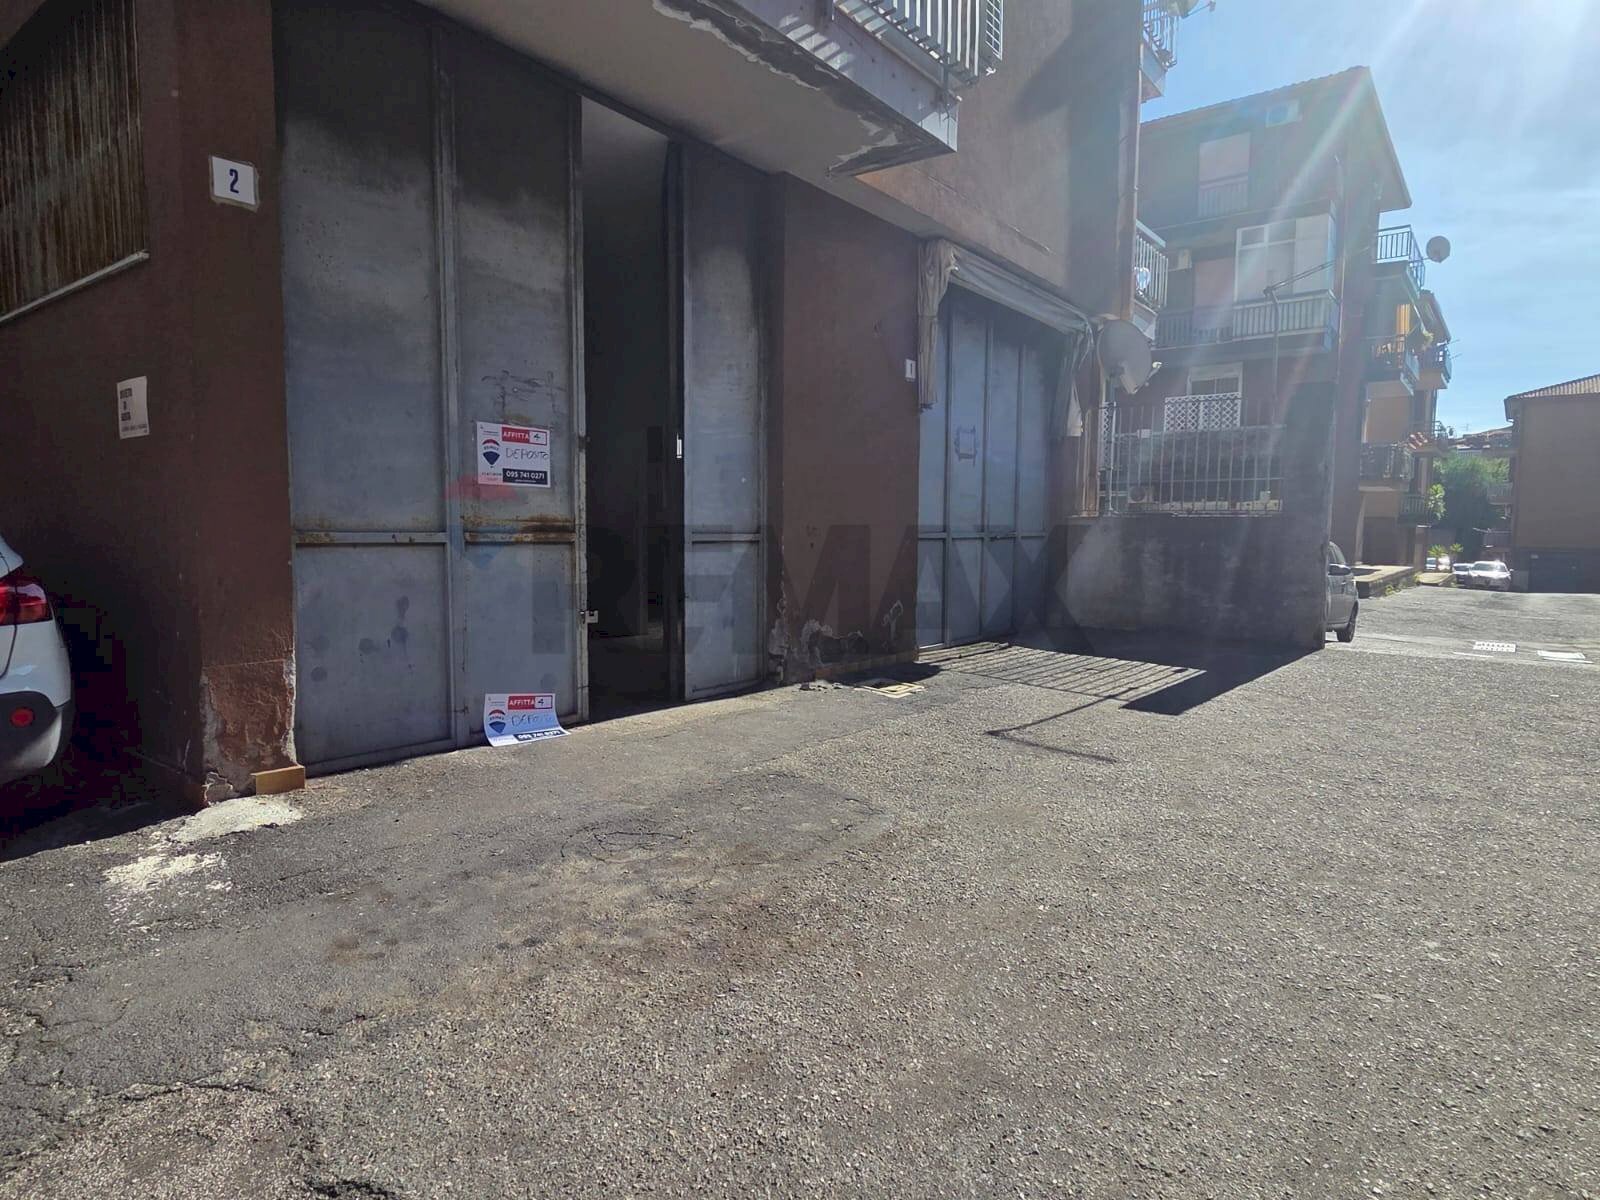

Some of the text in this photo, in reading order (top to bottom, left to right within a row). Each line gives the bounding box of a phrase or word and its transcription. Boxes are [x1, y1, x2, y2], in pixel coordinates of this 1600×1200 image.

[229, 168, 239, 194] 2
[503, 431, 529, 441] AFFITTA
[506, 470, 519, 478] 095
[520, 471, 530, 479] 741
[530, 472, 545, 480] 0271
